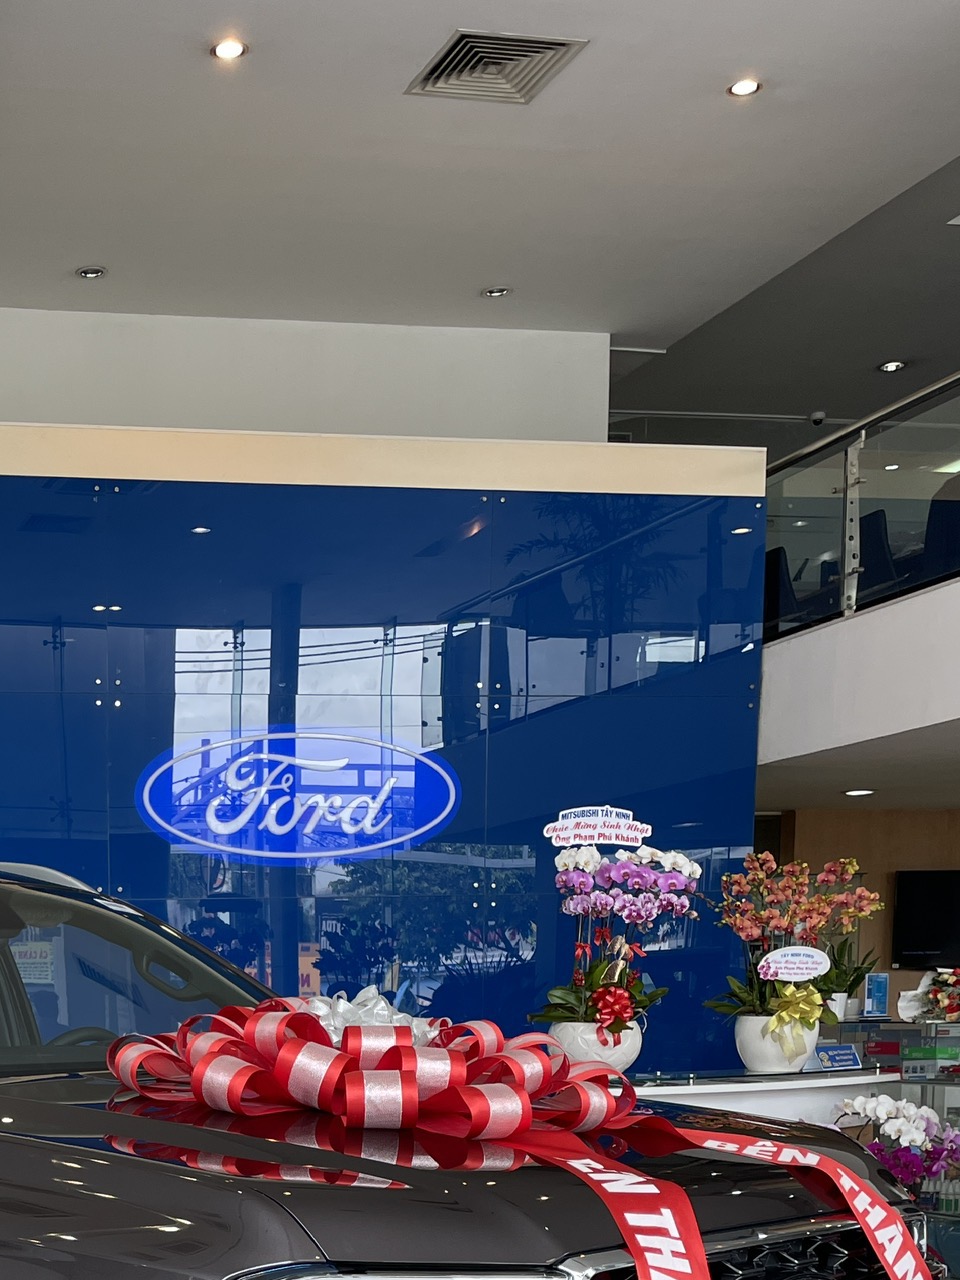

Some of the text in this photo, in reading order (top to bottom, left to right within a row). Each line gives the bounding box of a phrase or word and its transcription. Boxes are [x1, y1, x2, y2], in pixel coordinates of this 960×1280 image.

[205, 752, 399, 836] Ford
[561, 808, 631, 820] MITSUBISHI TÂY NINH
[546, 820, 650, 835] Chúc Mừng Sinh Nhật
[555, 832, 639, 844] Ông Phạm Phú Khánh
